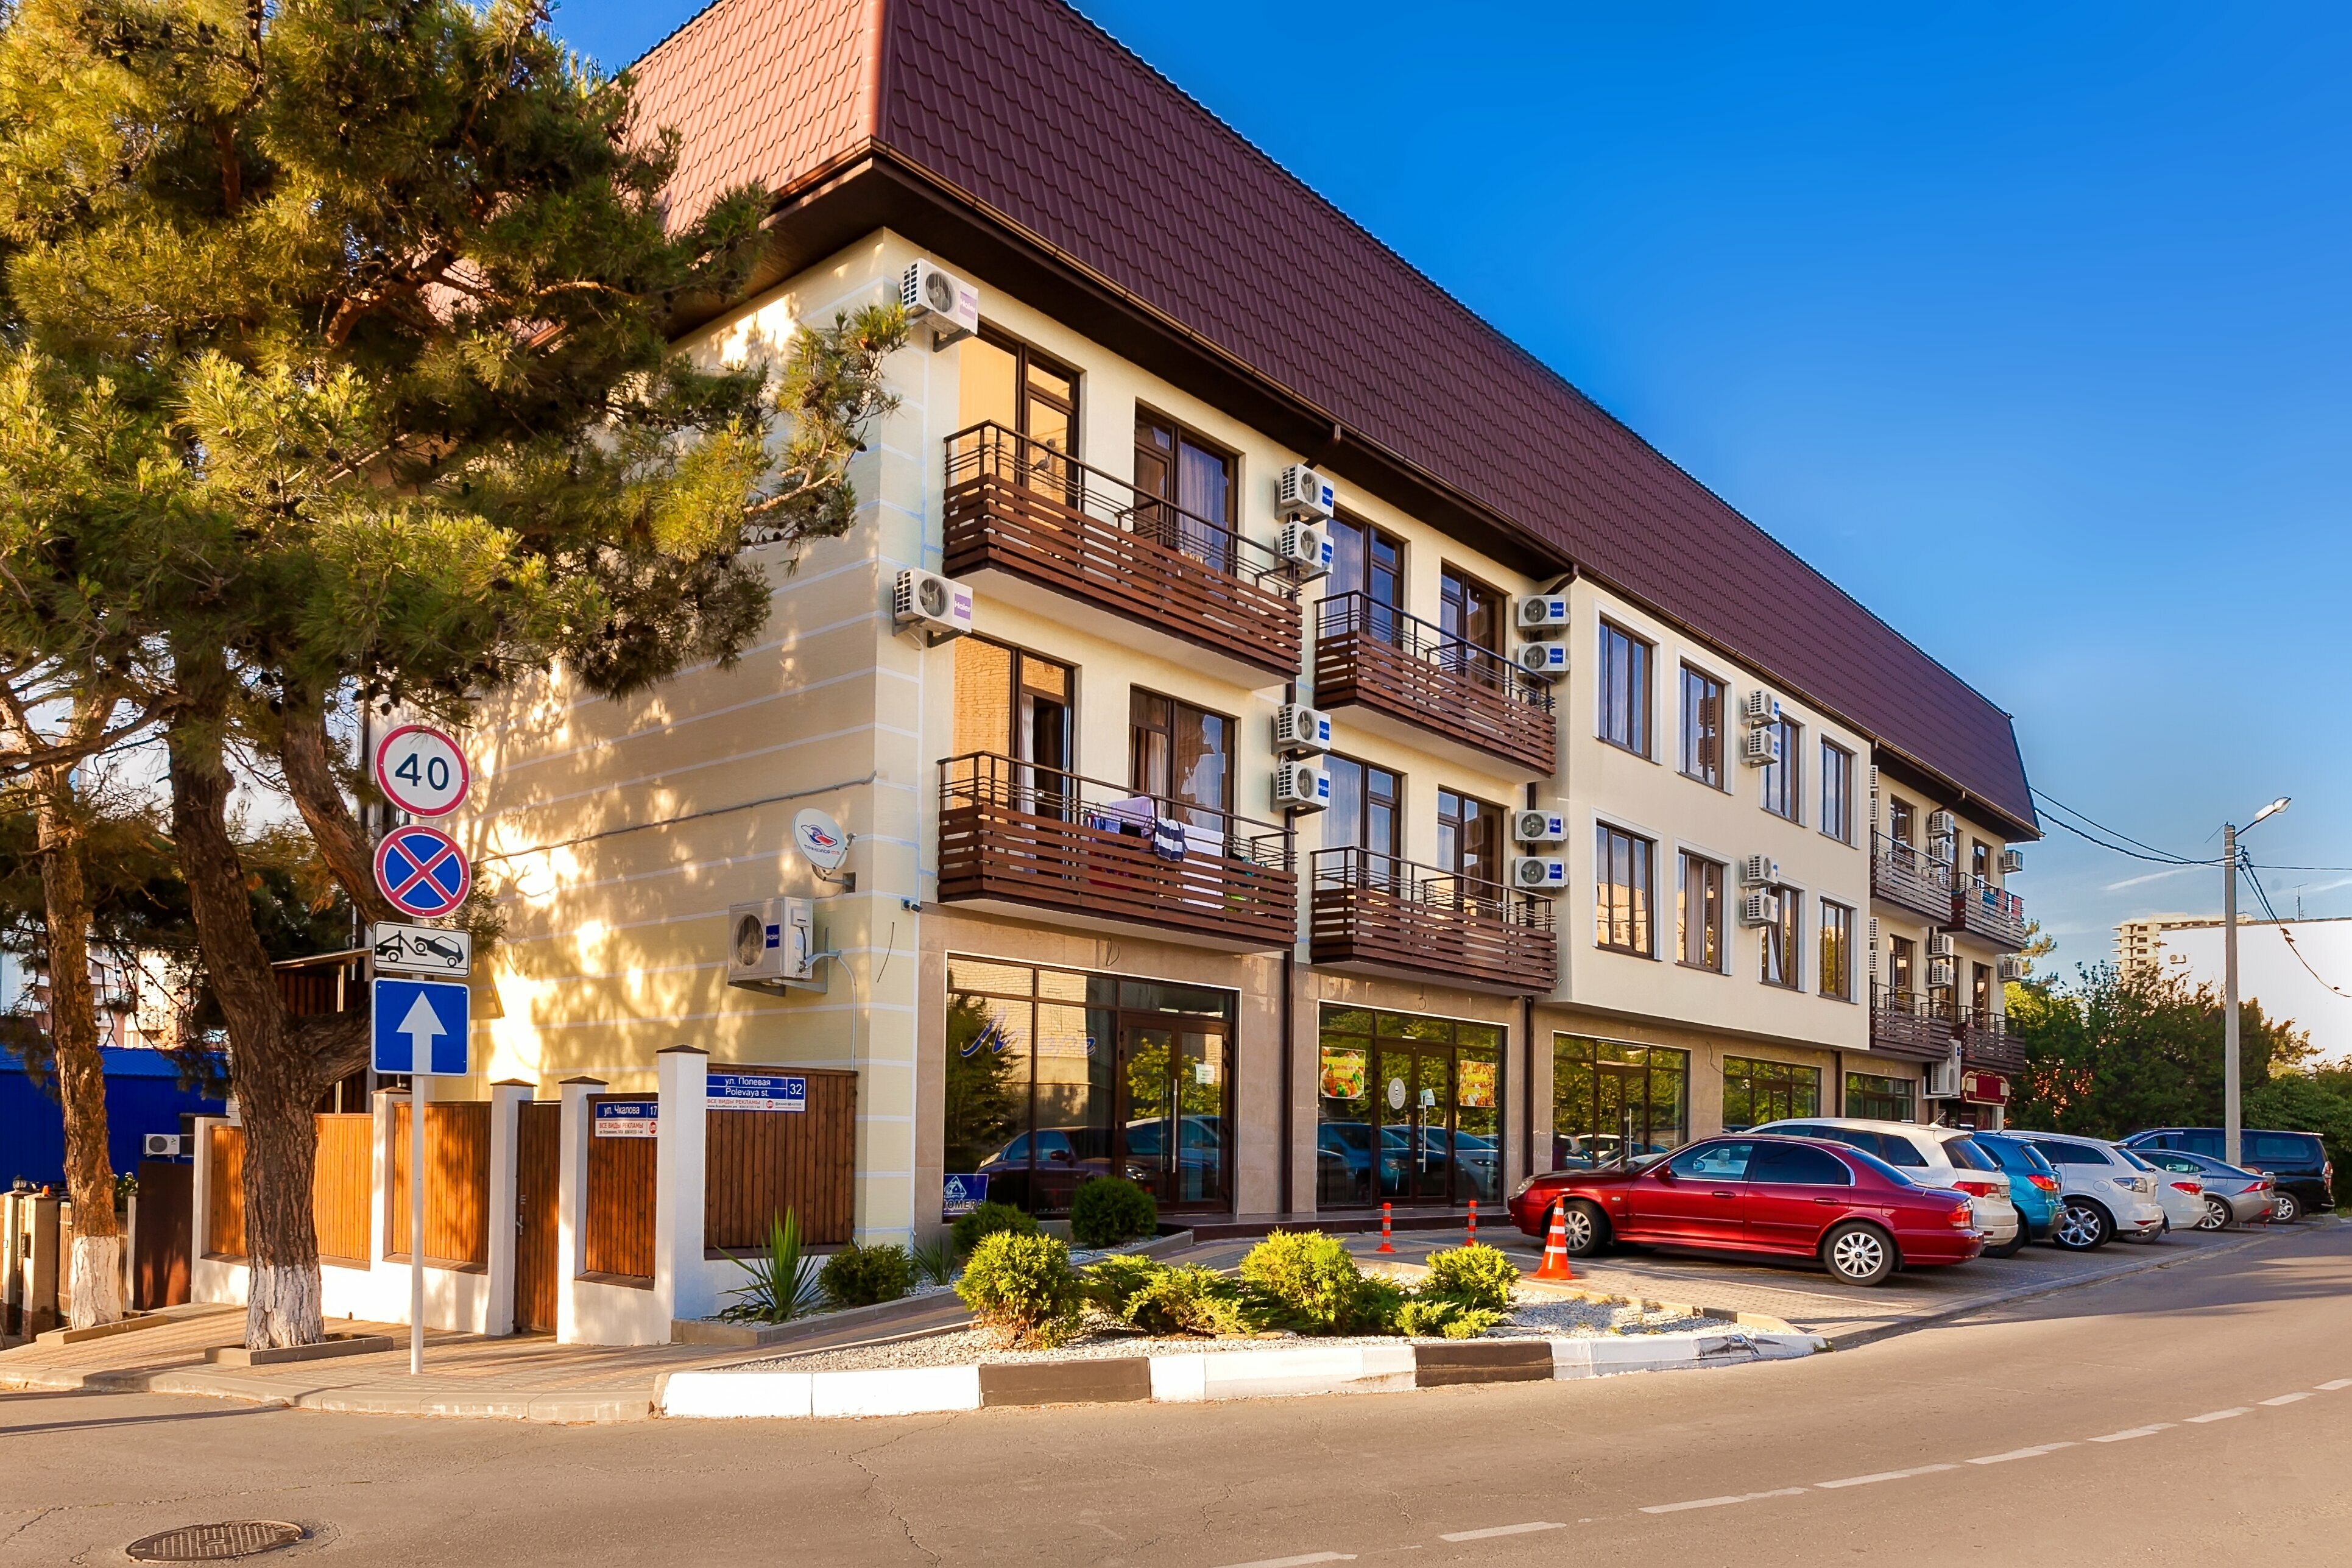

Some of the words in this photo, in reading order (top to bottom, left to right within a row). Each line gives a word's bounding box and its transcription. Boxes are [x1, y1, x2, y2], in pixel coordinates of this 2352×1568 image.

[959, 298, 976, 313] Haier
[954, 601, 971, 613] Haier
[394, 753, 450, 791] 40
[766, 933, 780, 941] Haier
[738, 1077, 771, 1086] Полевая
[726, 1087, 759, 1098] Polevaya
[789, 1084, 802, 1095] 32
[604, 1107, 613, 1117] ул.
[614, 1104, 640, 1114] Чкалова
[649, 1106, 657, 1115] 17
